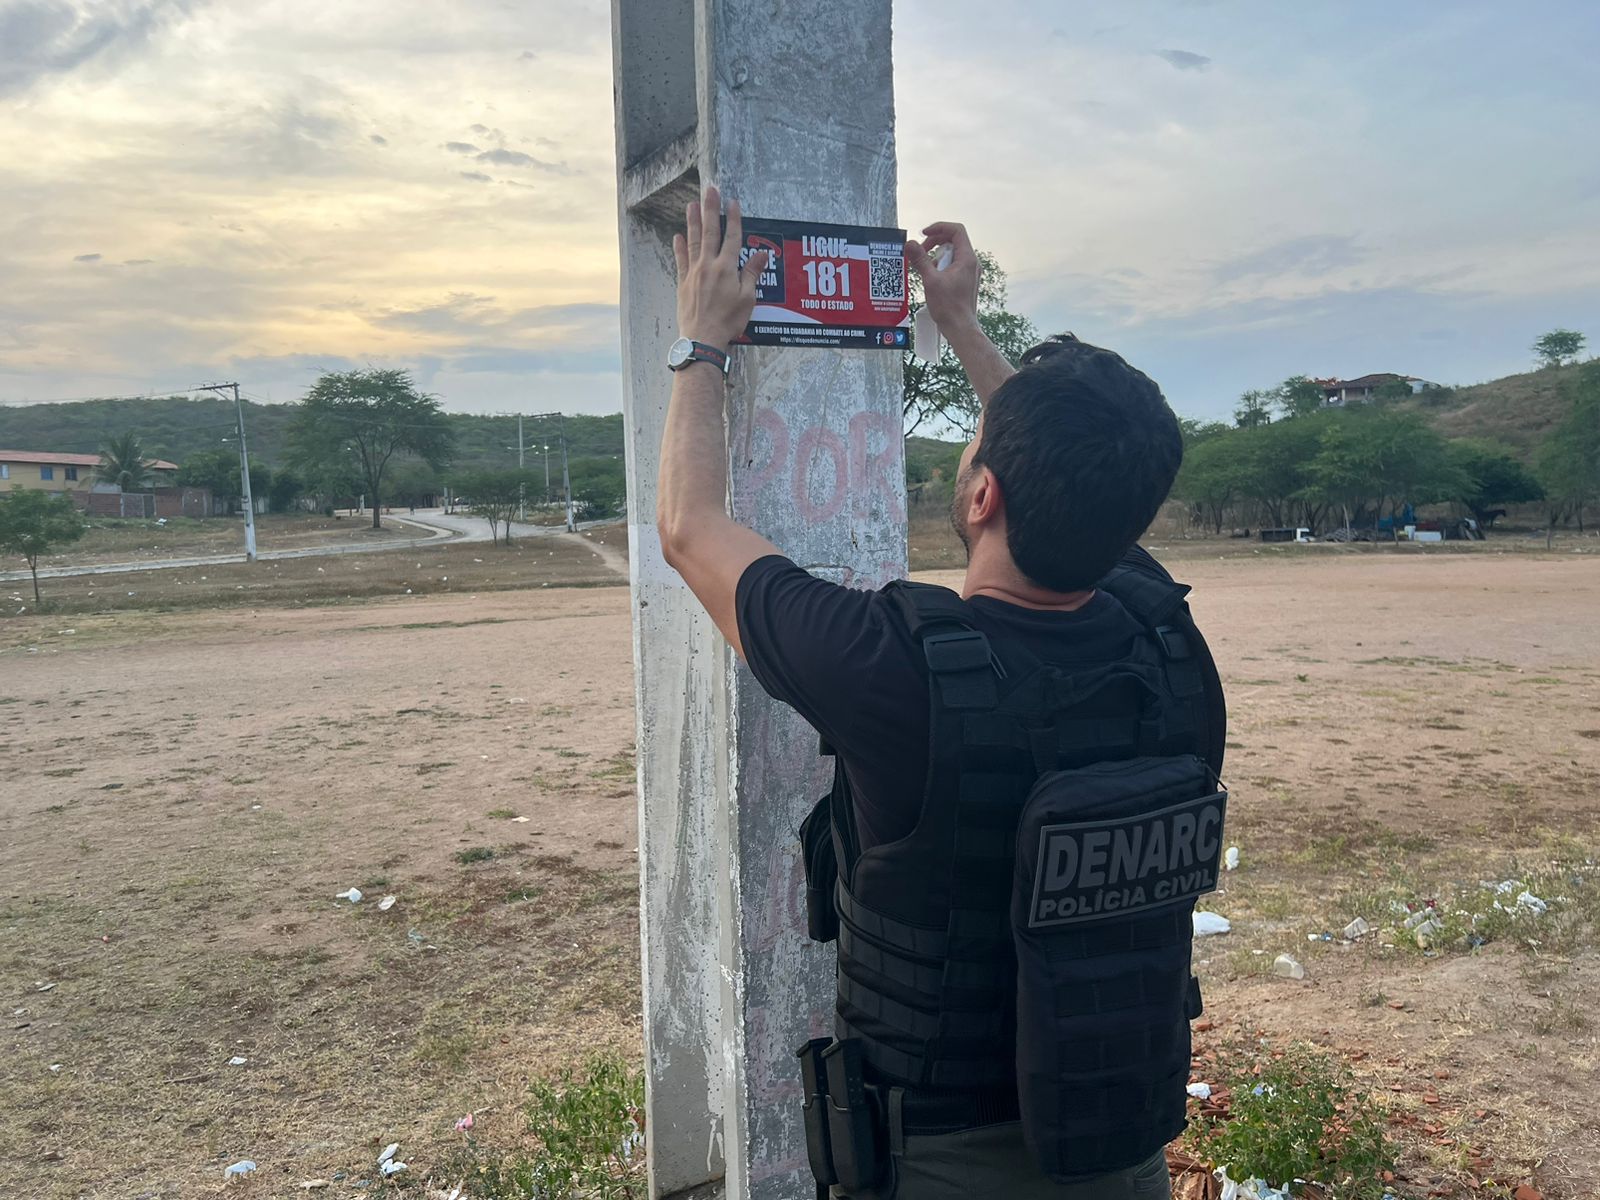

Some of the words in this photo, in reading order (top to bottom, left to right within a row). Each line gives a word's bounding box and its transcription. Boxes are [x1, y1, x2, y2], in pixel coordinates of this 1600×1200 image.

[802, 235, 848, 258] LIGUE
[803, 261, 850, 297] 181
[801, 299, 820, 309] TODO
[822, 300, 827, 310] O
[828, 300, 854, 311] ESTADO
[759, 325, 783, 334] EXERCÍCIO
[784, 327, 790, 335] DA
[816, 328, 822, 336] NO
[1044, 805, 1221, 892] DENARC
[1039, 886, 1147, 920] POLÍCIA
[1154, 868, 1214, 900] CIVIL
